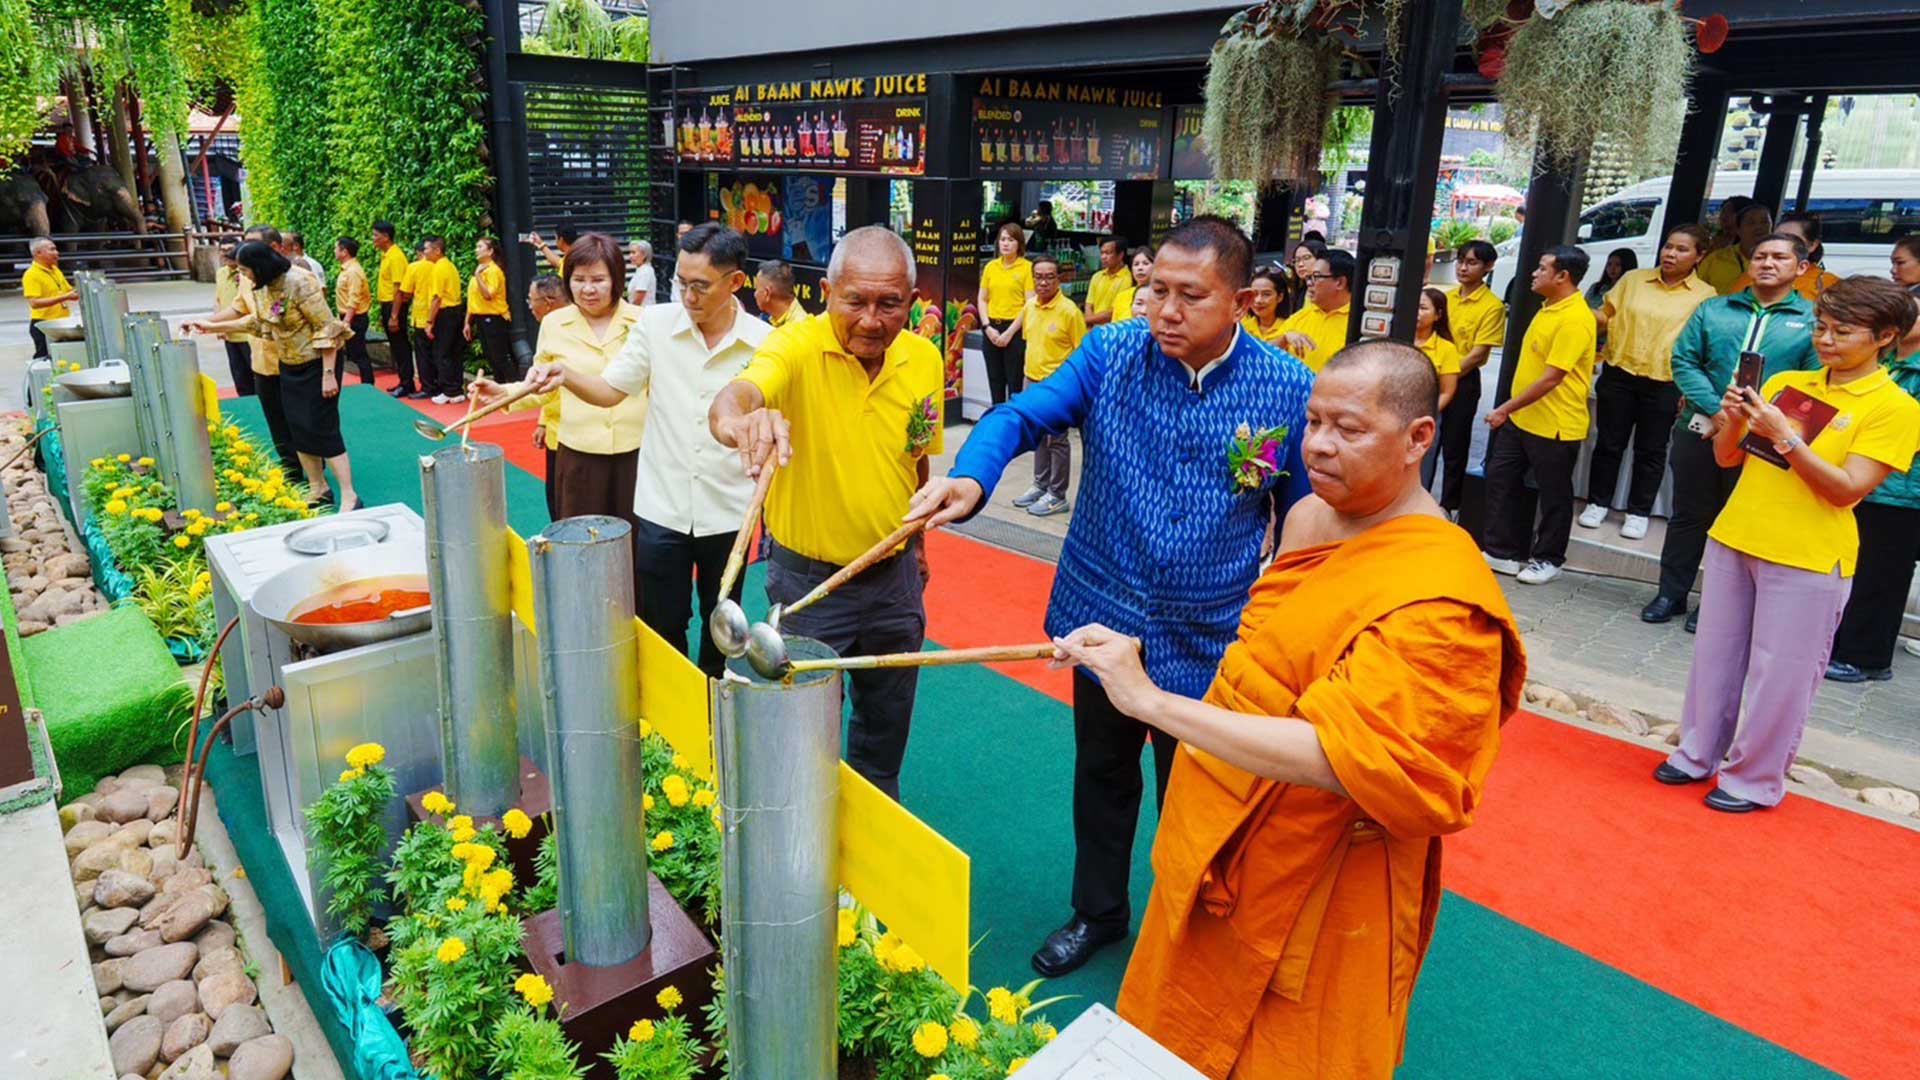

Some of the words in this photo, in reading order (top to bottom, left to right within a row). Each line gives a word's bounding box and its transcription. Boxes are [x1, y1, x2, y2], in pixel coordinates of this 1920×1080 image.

[735, 84, 750, 101] AI
[757, 82, 801, 100] BAAN
[810, 77, 864, 98] NAWK
[874, 73, 927, 96] JUICE
[980, 77, 1001, 97] AI
[1008, 80, 1061, 100] BAAN
[1067, 85, 1116, 105] NAWK
[1123, 89, 1163, 108] JUICE
[709, 95, 730, 107] JUICE
[977, 109, 1013, 121] BLENDED
[923, 218, 933, 228] AI
[960, 219, 970, 228] AI
[915, 230, 941, 241] BAAN
[953, 231, 977, 241] BAAN
[915, 242, 941, 252] NAWK
[952, 243, 977, 253] NAWK
[916, 254, 938, 266] JUICE
[953, 255, 975, 266] JUICE
